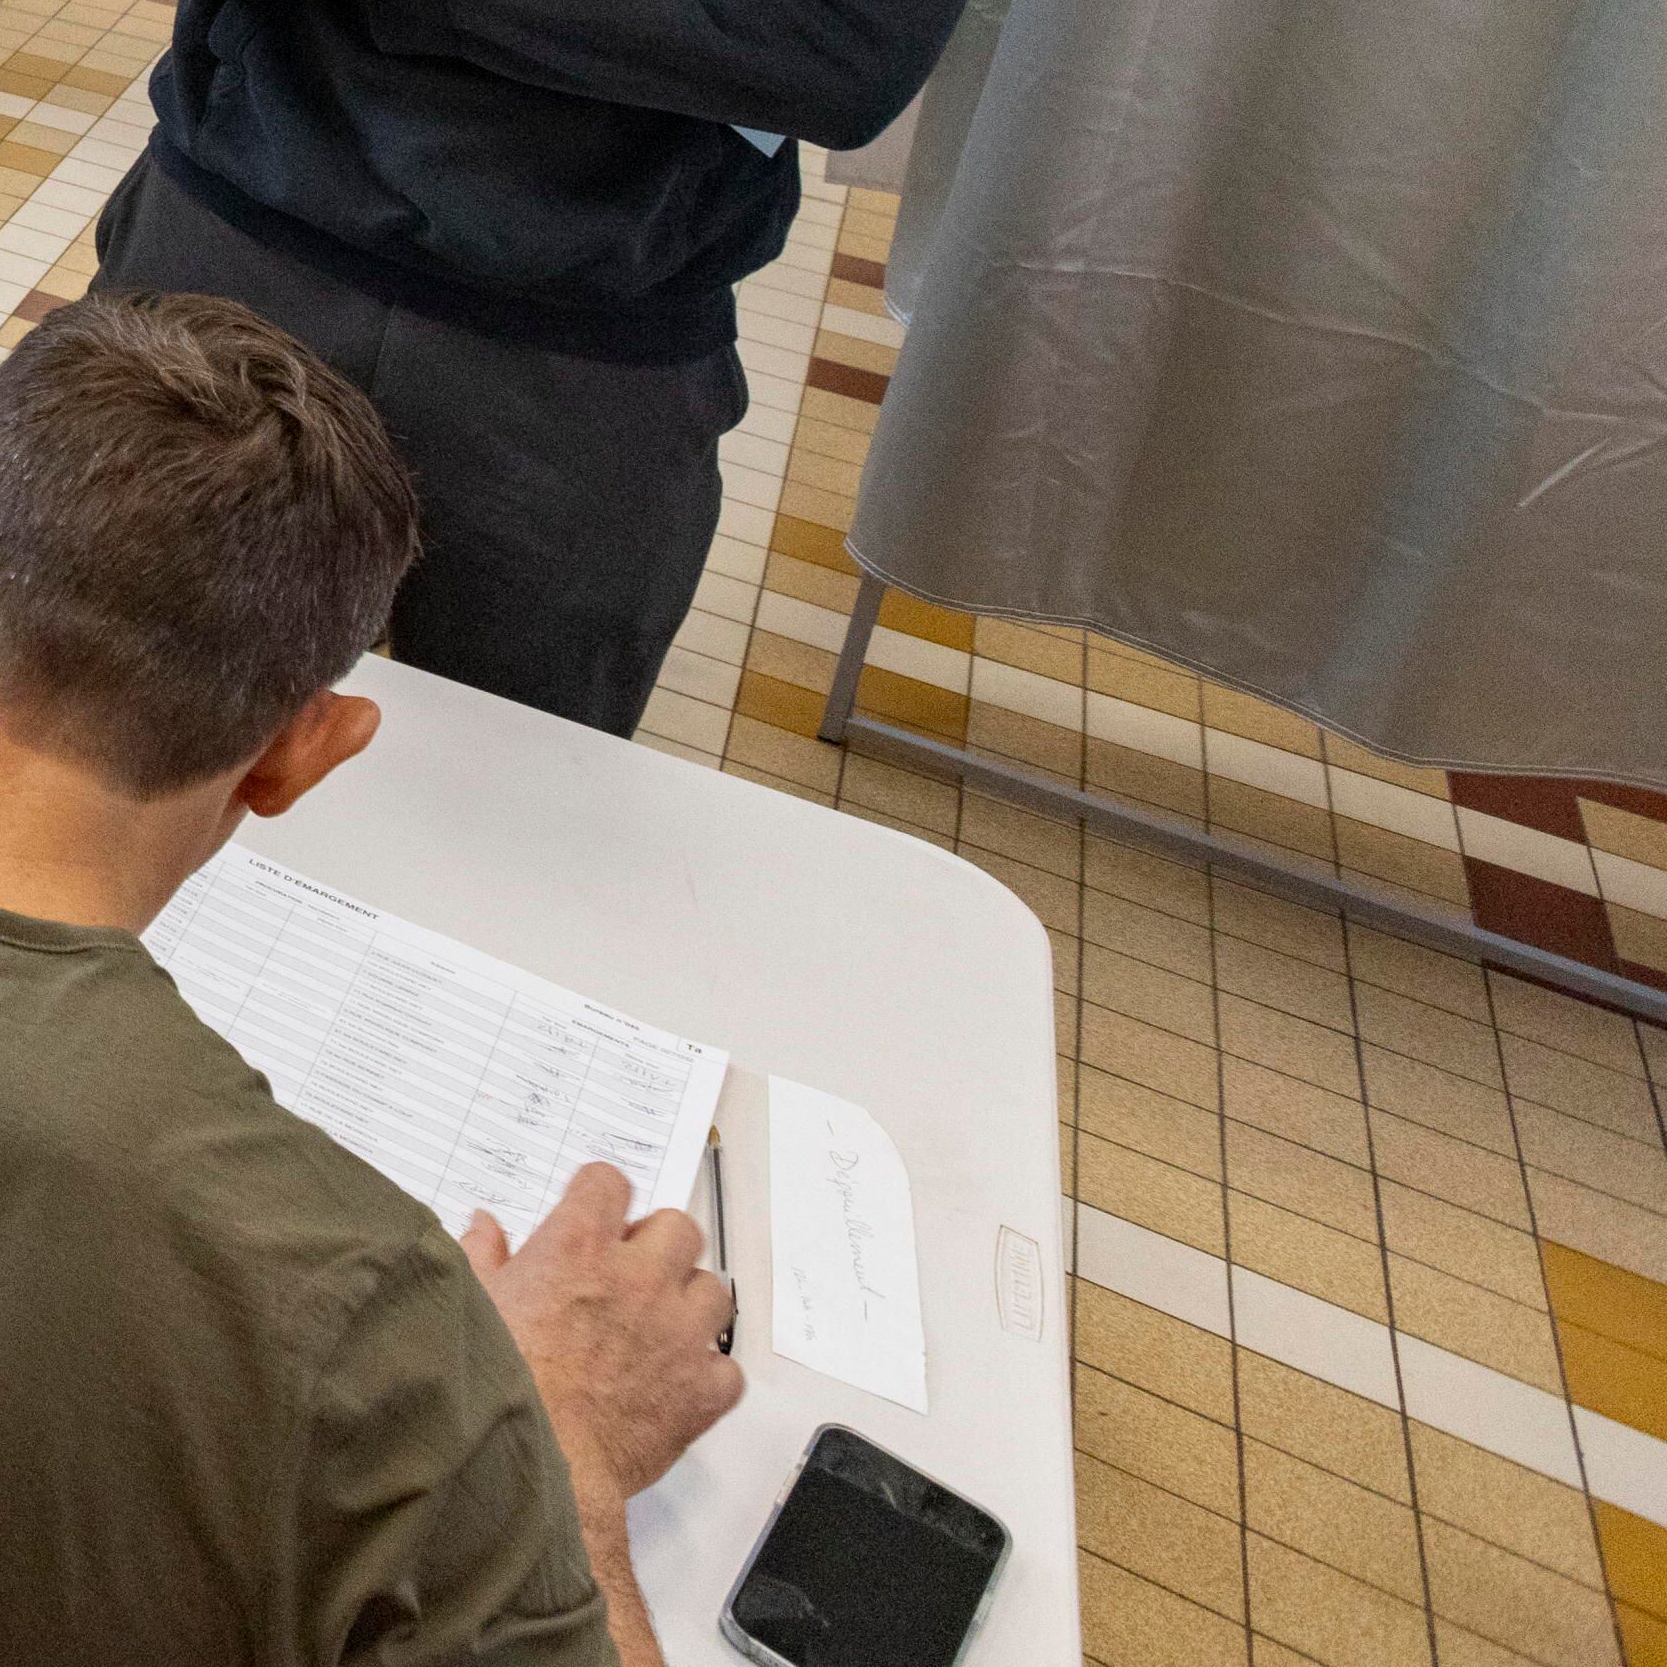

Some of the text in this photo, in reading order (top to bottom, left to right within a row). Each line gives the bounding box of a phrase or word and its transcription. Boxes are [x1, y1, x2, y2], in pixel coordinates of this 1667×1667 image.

[248, 858, 281, 878] LISTE
[283, 873, 380, 921] D'ÉMARGEMENT
[686, 1043, 703, 1055] Ta
